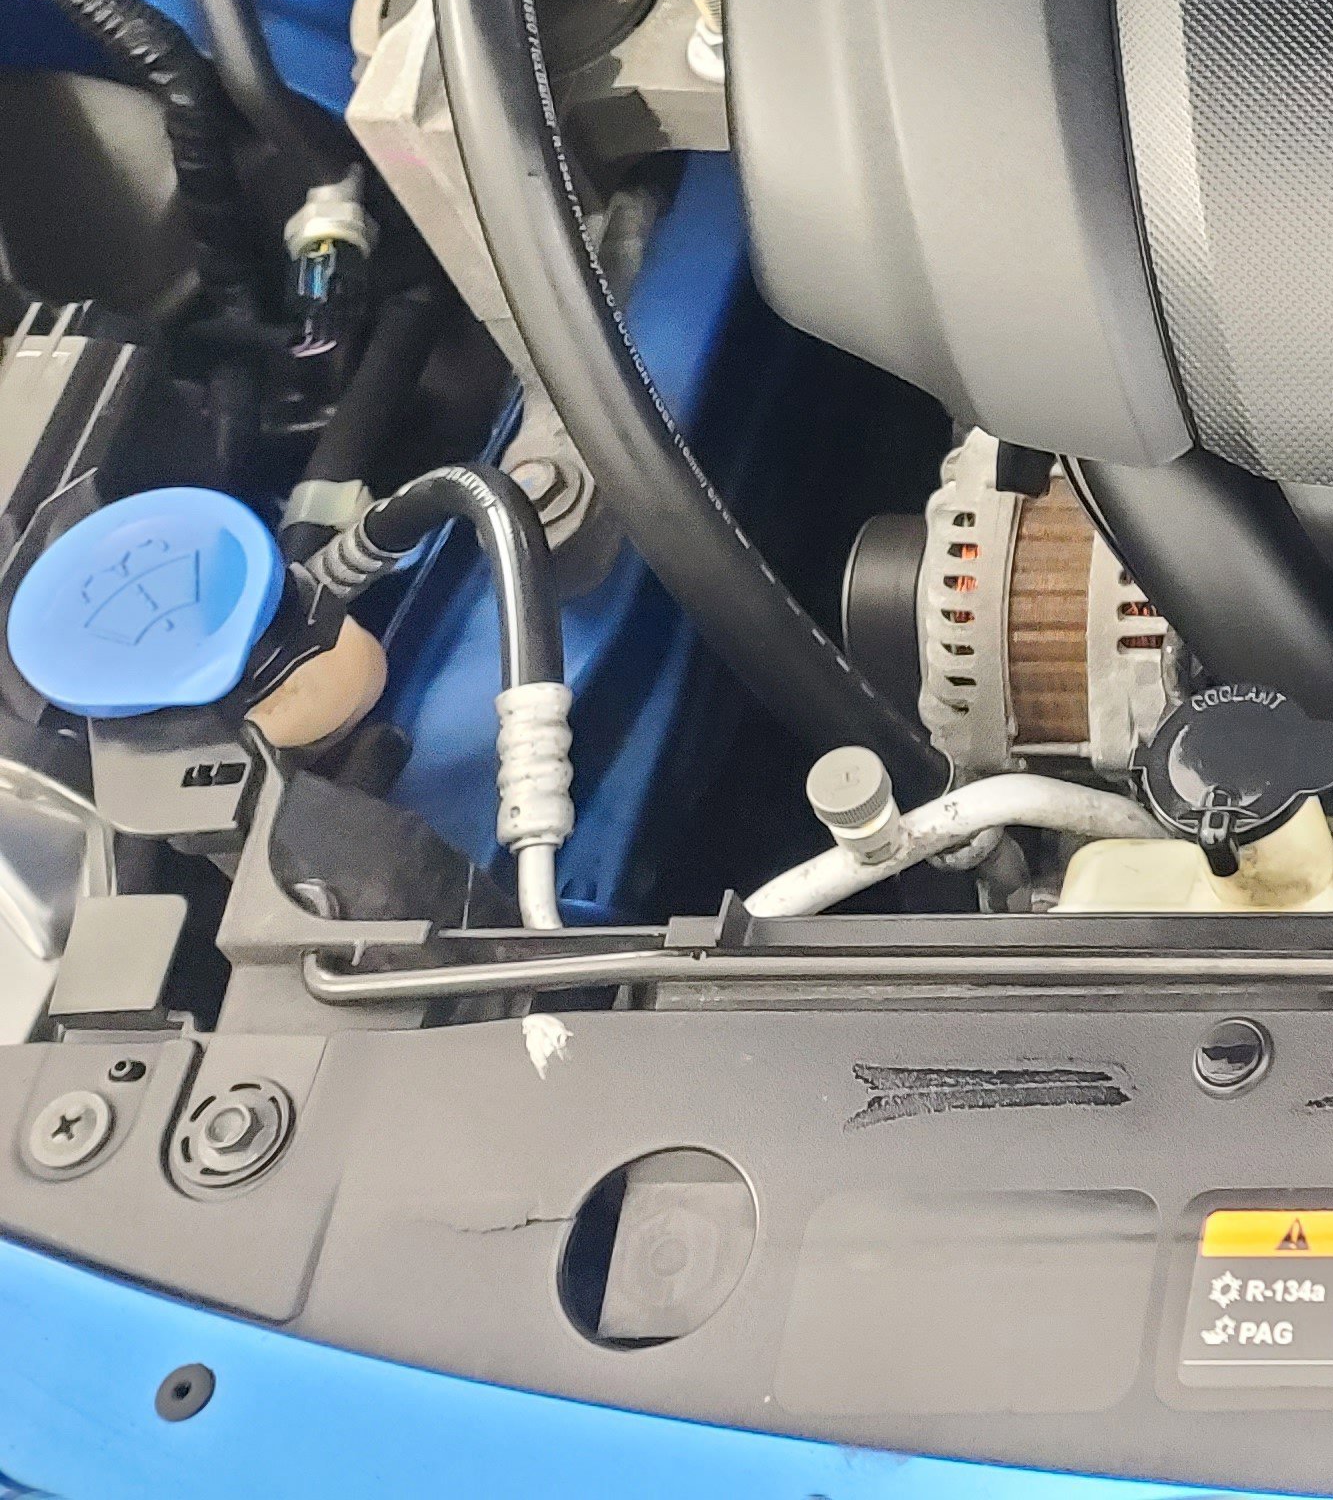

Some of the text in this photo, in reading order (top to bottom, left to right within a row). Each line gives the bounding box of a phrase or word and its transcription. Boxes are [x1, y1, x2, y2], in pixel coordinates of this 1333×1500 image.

[1191, 684, 1287, 711] COOLANT
[1245, 1280, 1326, 1303] R-134a
[1238, 1322, 1294, 1345] PAG
